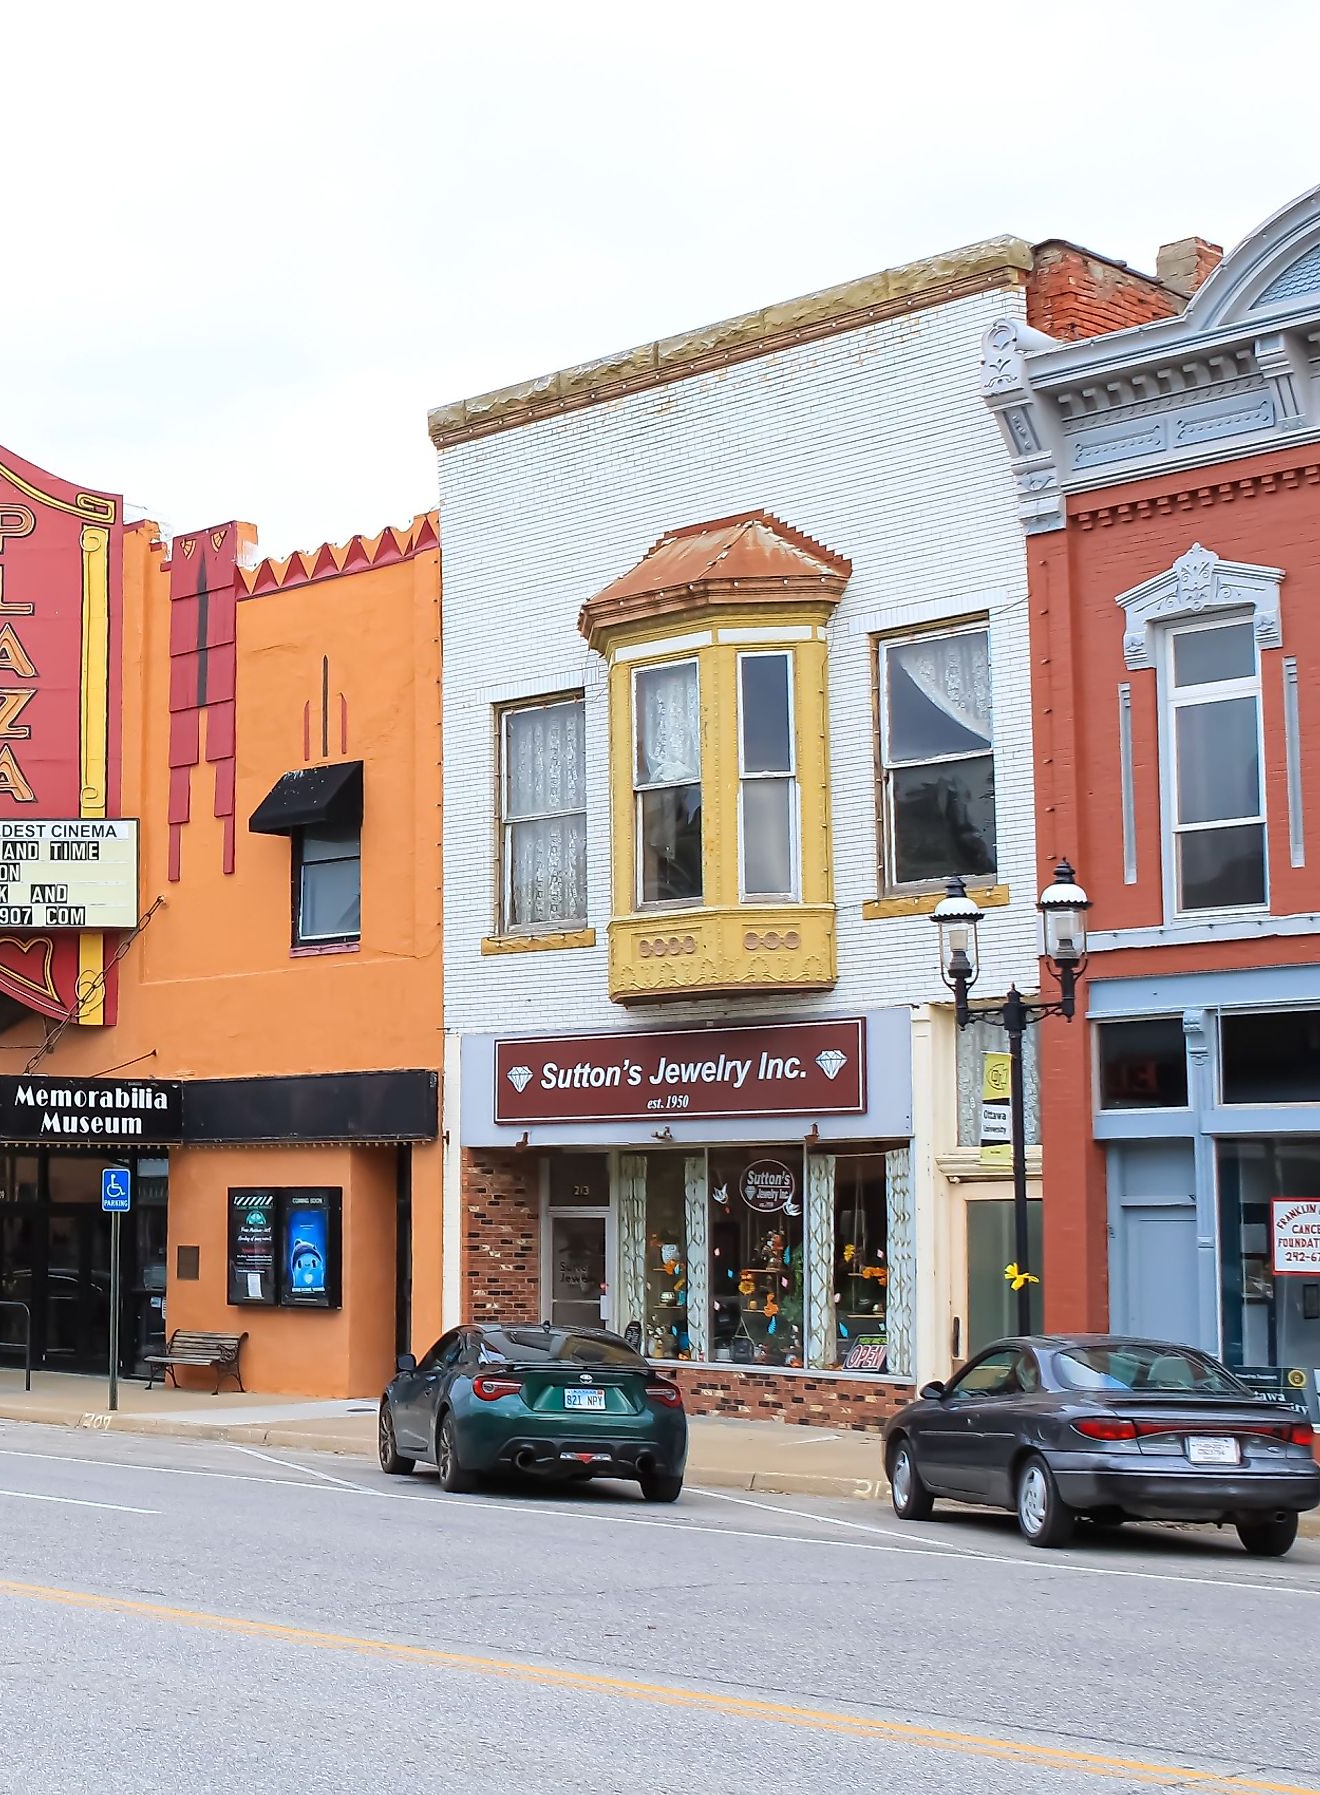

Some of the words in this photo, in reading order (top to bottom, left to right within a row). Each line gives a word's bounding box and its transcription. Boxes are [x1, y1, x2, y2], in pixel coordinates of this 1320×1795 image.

[51, 824, 117, 838] CINEMA
[3, 841, 39, 860] AND
[50, 841, 99, 860] TIME
[31, 884, 67, 903] AND
[46, 906, 85, 925] COM
[540, 1059, 643, 1090] Sutton's
[649, 1054, 752, 1089] Jewelry
[757, 1051, 807, 1080] Inc.
[15, 1085, 168, 1109] Memorabilia
[647, 1097, 664, 1109] est.
[666, 1094, 689, 1109] 1950
[40, 1111, 143, 1135] Museum
[983, 1109, 1007, 1121] Ottawa
[747, 1170, 791, 1185] Sutton's
[104, 1199, 128, 1208] PARKING
[1276, 1203, 1317, 1230] FRANKLIN
[846, 1345, 886, 1368] OPEN
[566, 1394, 582, 1406] 821
[587, 1395, 603, 1406] NPY
